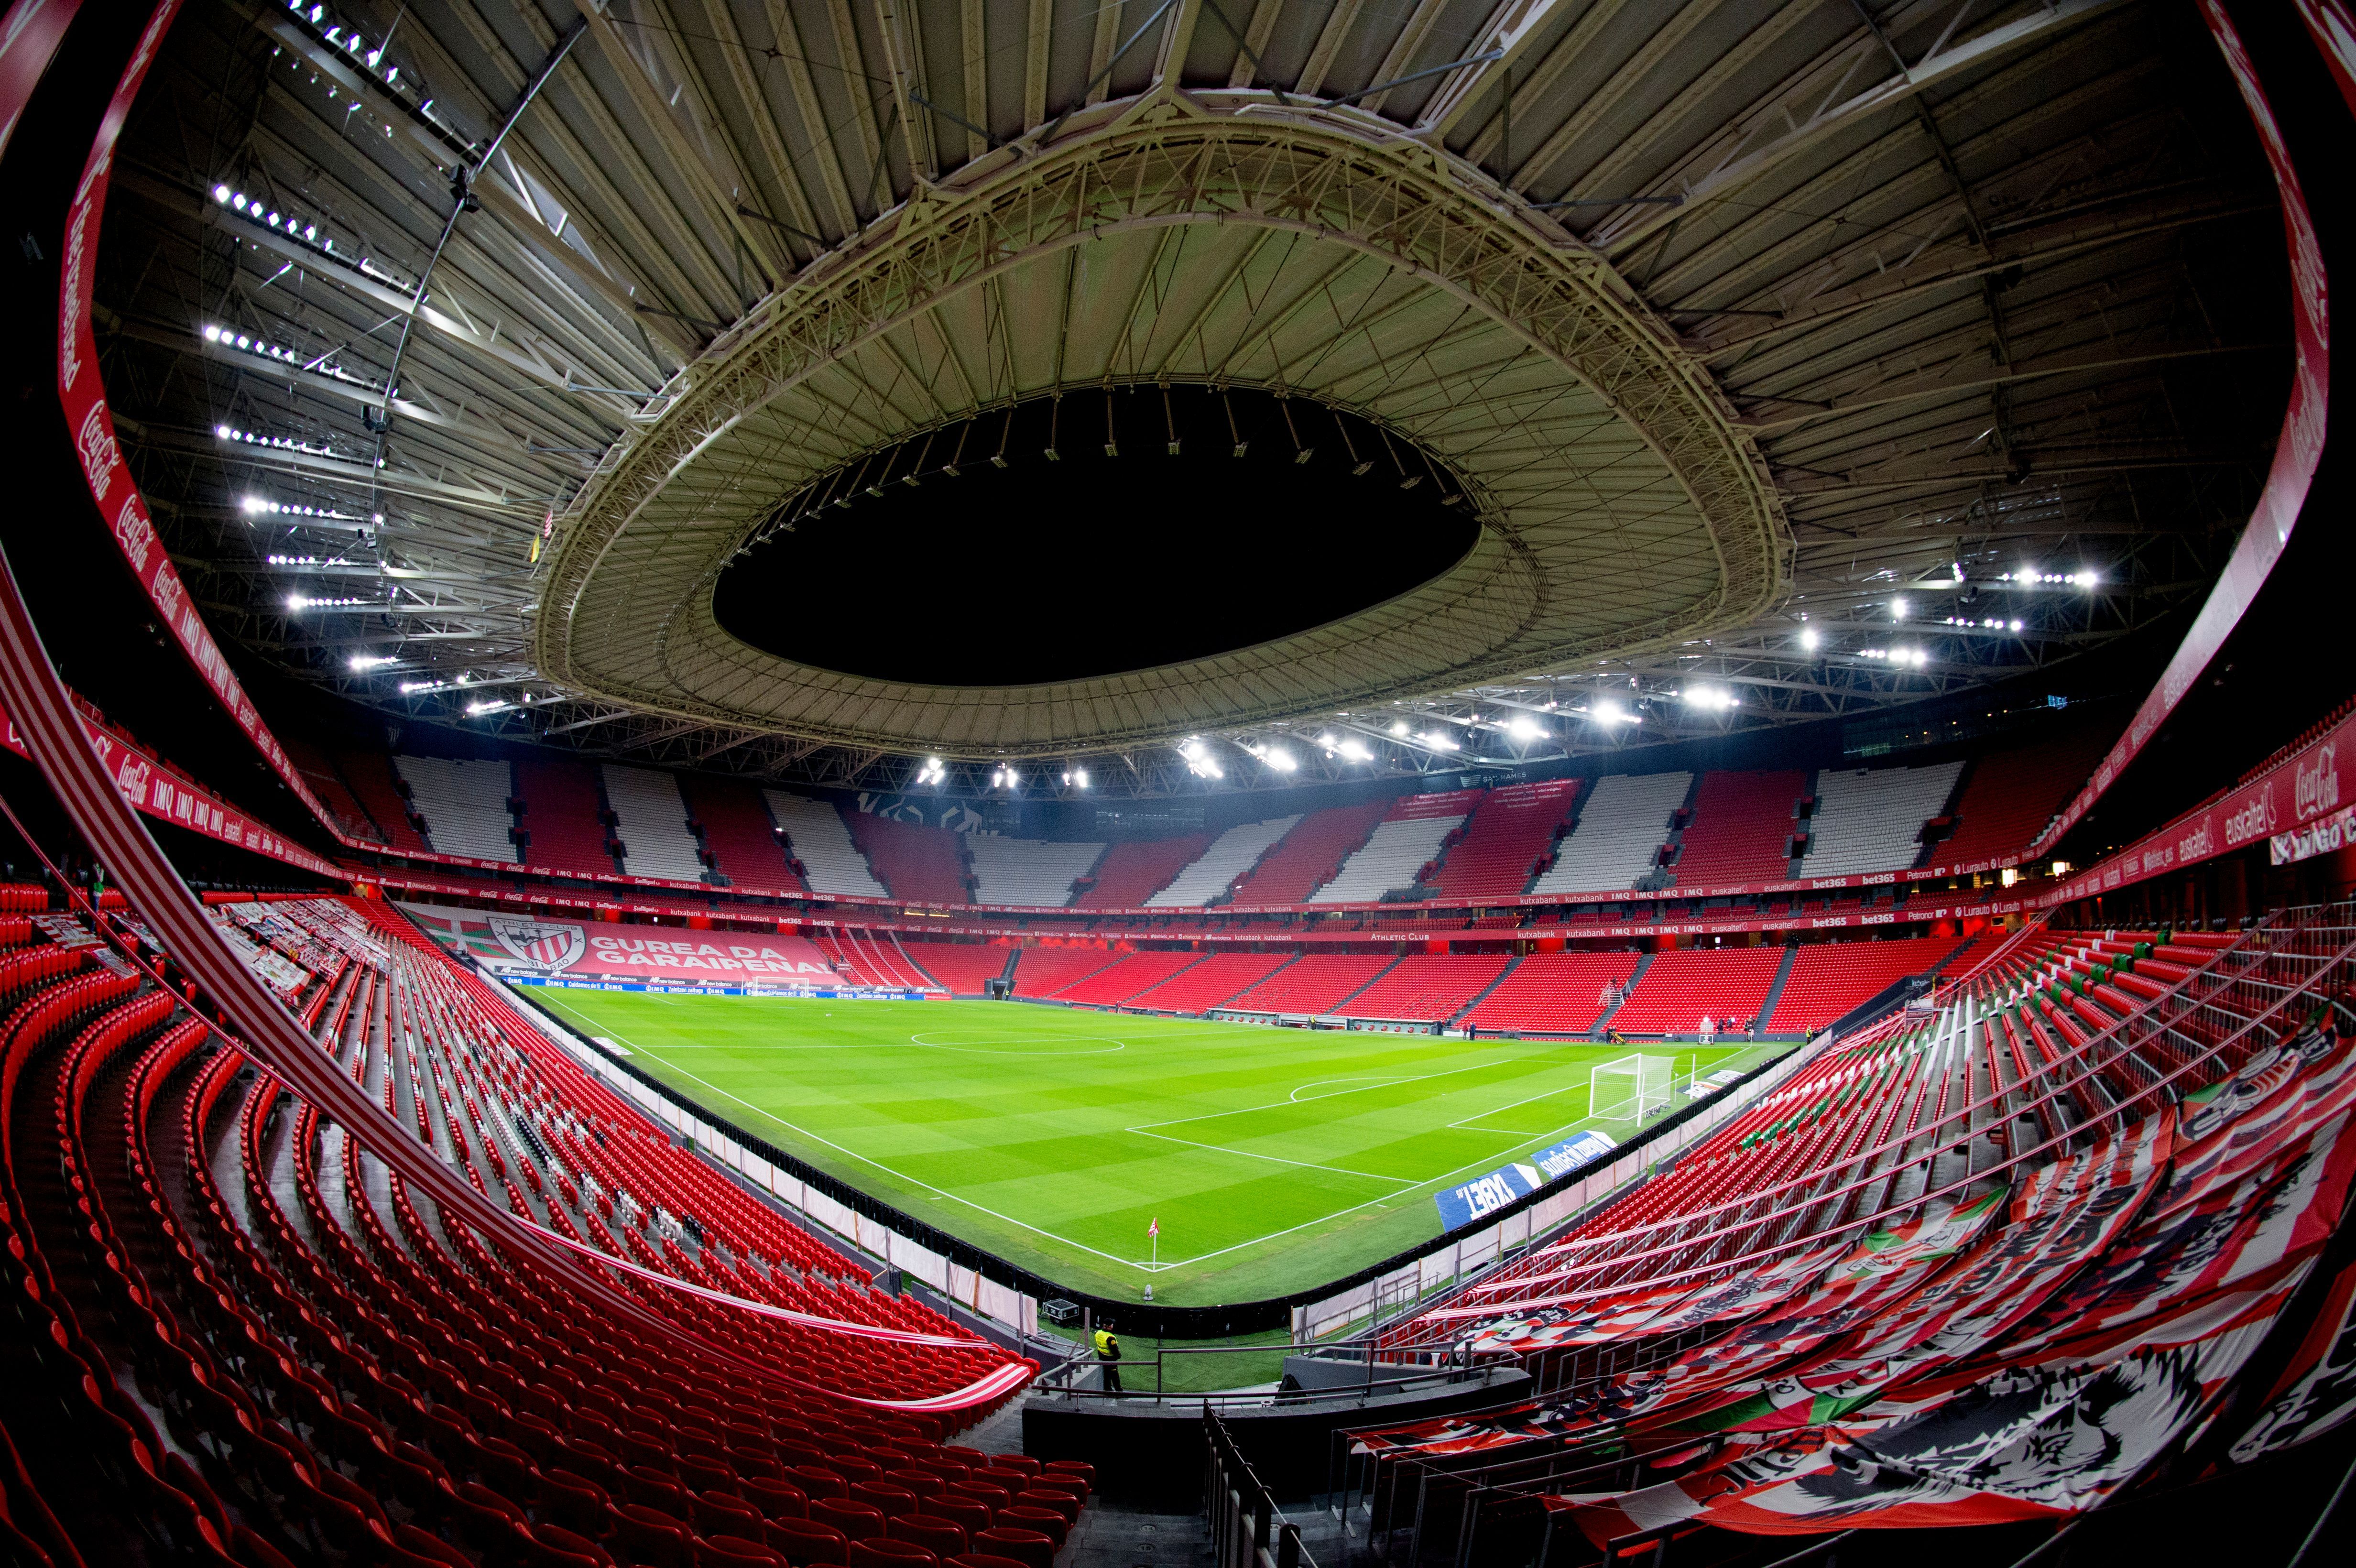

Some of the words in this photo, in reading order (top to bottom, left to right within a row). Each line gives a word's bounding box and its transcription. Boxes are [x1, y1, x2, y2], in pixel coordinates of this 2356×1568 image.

[79, 400, 120, 501] Coca-Cola
[117, 494, 154, 572] Coca-Cola
[153, 559, 182, 621] Coca-Cola
[182, 607, 199, 656] IMQ
[199, 636, 215, 679] IMQ
[214, 659, 228, 698] IMQ
[227, 680, 239, 714] IMQ
[153, 778, 174, 818] IMQ
[176, 791, 193, 826] IMQ
[195, 800, 209, 831] IMQ
[210, 809, 223, 837] IMQ
[2225, 794, 2267, 845] euskaltel
[481, 861, 499, 869] Coca-Cola
[507, 864, 525, 872] Coca-Cola
[1963, 861, 1989, 874] Lurauto
[1998, 855, 2018, 868] Lurauto
[1907, 870, 1932, 880] Petronor
[670, 881, 700, 890] kutxabank
[1813, 878, 1846, 889] bet365
[1863, 874, 1895, 885] bet365
[1684, 888, 1703, 896] IMQ
[1712, 886, 1742, 895] euskaltel
[1764, 883, 1795, 892] euskaltel
[480, 890, 498, 898] Coca-Cola
[505, 893, 523, 901] Coca-Cola
[1520, 896, 1557, 904] kutxabank
[1565, 894, 1604, 903] kutxabank
[1963, 904, 1990, 917] Lurauto
[1999, 901, 2020, 913] Lurauto
[670, 909, 701, 917] kutxabank
[706, 912, 736, 920] kutxabank
[741, 914, 770, 922] kutxabank
[1813, 917, 1847, 927] bet365
[1862, 914, 1895, 925] bet365
[1909, 912, 1934, 920] Petronor
[494, 920, 545, 928] ATHLETIC
[1684, 925, 1703, 933] IMQ
[1712, 924, 1741, 932] euskaltel
[1762, 921, 1793, 930] euskaltel
[1567, 929, 1605, 937] kutxabank
[590, 936, 727, 957] GUREA
[729, 946, 787, 960] DA
[597, 950, 833, 974] GARAIPENA!
